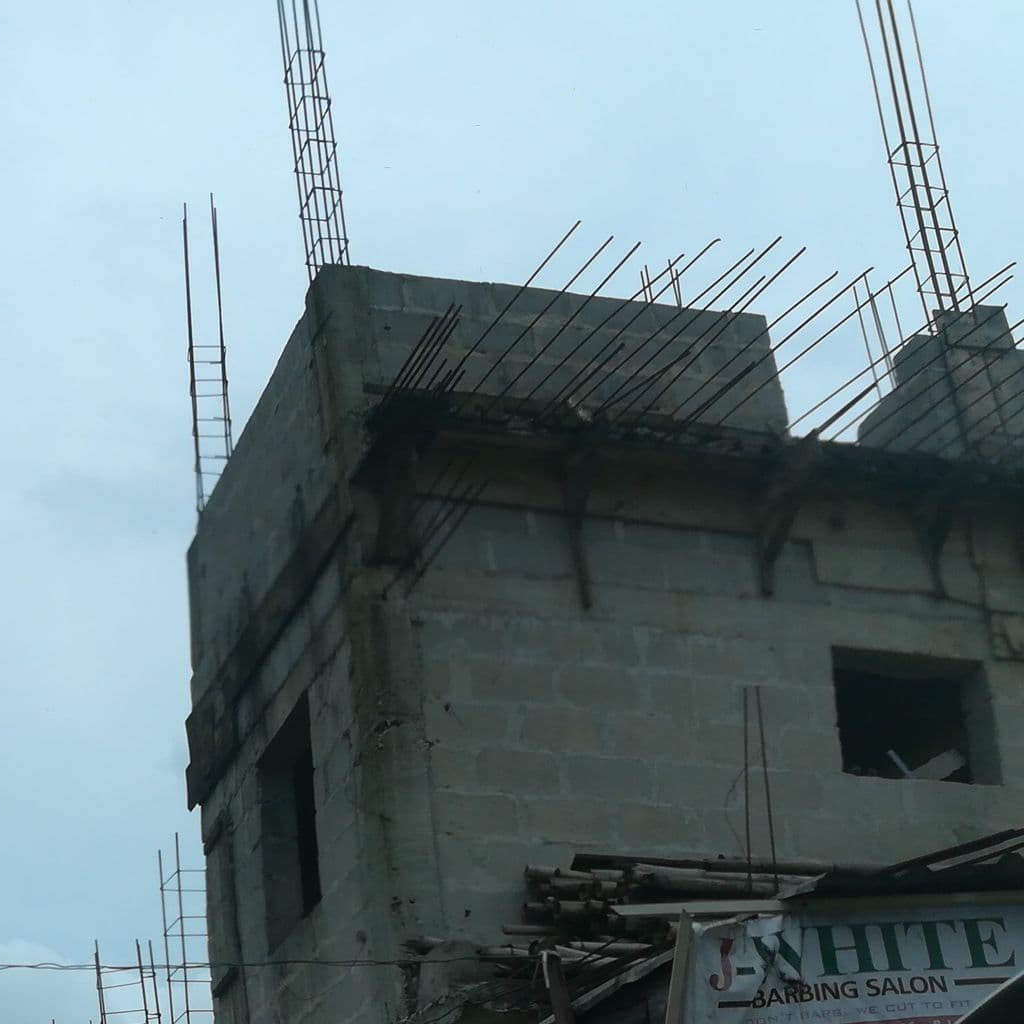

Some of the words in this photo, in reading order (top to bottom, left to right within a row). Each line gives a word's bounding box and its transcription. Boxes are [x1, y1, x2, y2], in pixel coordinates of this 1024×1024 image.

[752, 978, 858, 1008] BARBING
[865, 974, 948, 998] SALON
[886, 1001, 914, 1013] CUT
[922, 1000, 943, 1010] TO
